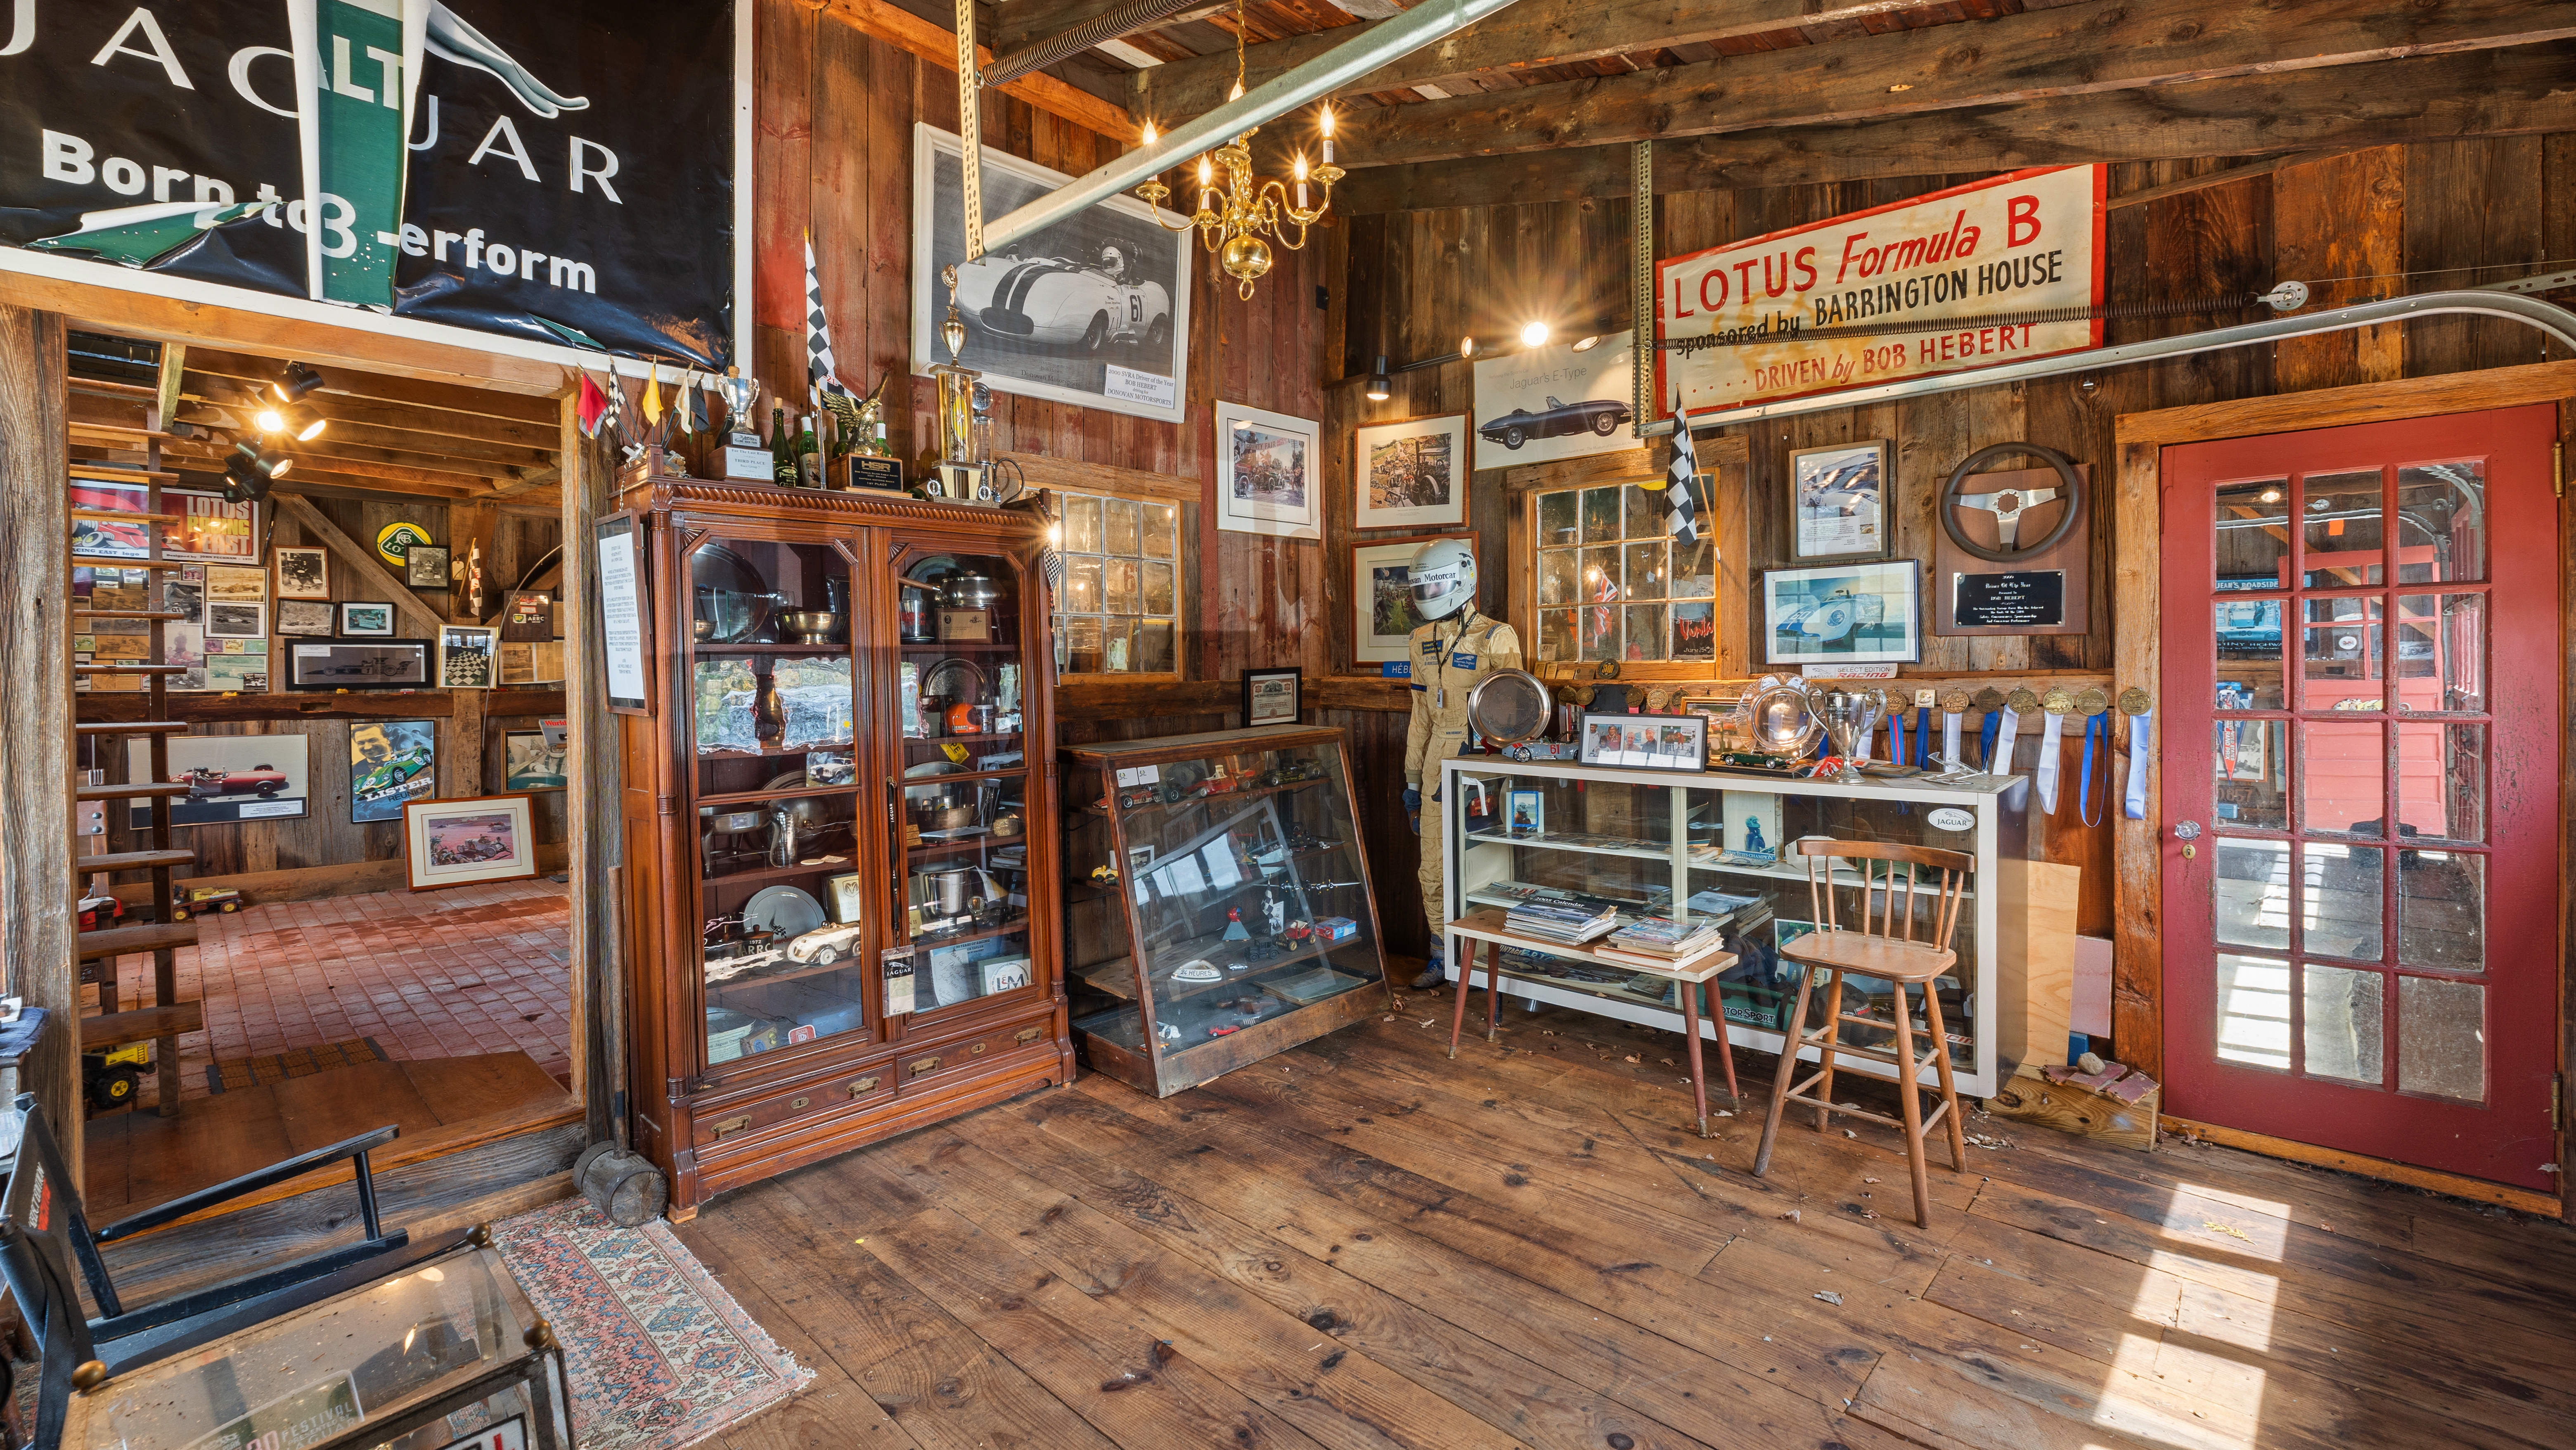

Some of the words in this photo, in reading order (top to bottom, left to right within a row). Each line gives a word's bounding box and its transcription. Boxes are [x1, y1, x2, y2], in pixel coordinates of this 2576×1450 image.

[400, 223, 596, 294] erform
[1674, 246, 1818, 319] LOTUS
[1836, 209, 1982, 284] Formula
[2007, 195, 2042, 249] B
[1777, 310, 1800, 340] by
[1815, 268, 1968, 326] BARRINGTON
[1978, 249, 2062, 296] HOUSE
[1129, 294, 1143, 322] 61
[1754, 358, 1826, 392] DRIVEN
[1831, 353, 1856, 384] by
[1863, 343, 1907, 374] BOB
[1920, 322, 2037, 364] HEBERT
[1021, 370, 1046, 380] Donovan
[1047, 375, 1081, 387] Motorsports
[1136, 374, 1150, 382] Driver
[1136, 381, 1158, 391] HEBERT
[1510, 373, 1550, 389] Jaguar's
[1553, 368, 1587, 381] E-Type
[1108, 388, 1134, 398] DONOVAN
[1134, 392, 1172, 405] MOTORSPORTS
[1265, 441, 1276, 449] FAIR
[862, 460, 891, 471] HSR
[187, 496, 249, 519] LOTUS
[187, 516, 250, 536] RACING
[202, 533, 250, 554] EAST
[1424, 573, 1456, 582] Motorcar
[1467, 614, 1475, 625] JAGUAR
[1789, 611, 1812, 620] 60
[1445, 647, 1454, 660] JAGUAR
[1601, 664, 1615, 673] SVRA
[1550, 744, 1560, 754] 61
[365, 777, 433, 802] LISTER
[388, 785, 430, 802] REUNION
[774, 936, 793, 945] Watkins
[887, 967, 912, 977] JAGUAR
[282, 1402, 353, 1442] FESTIVAL
